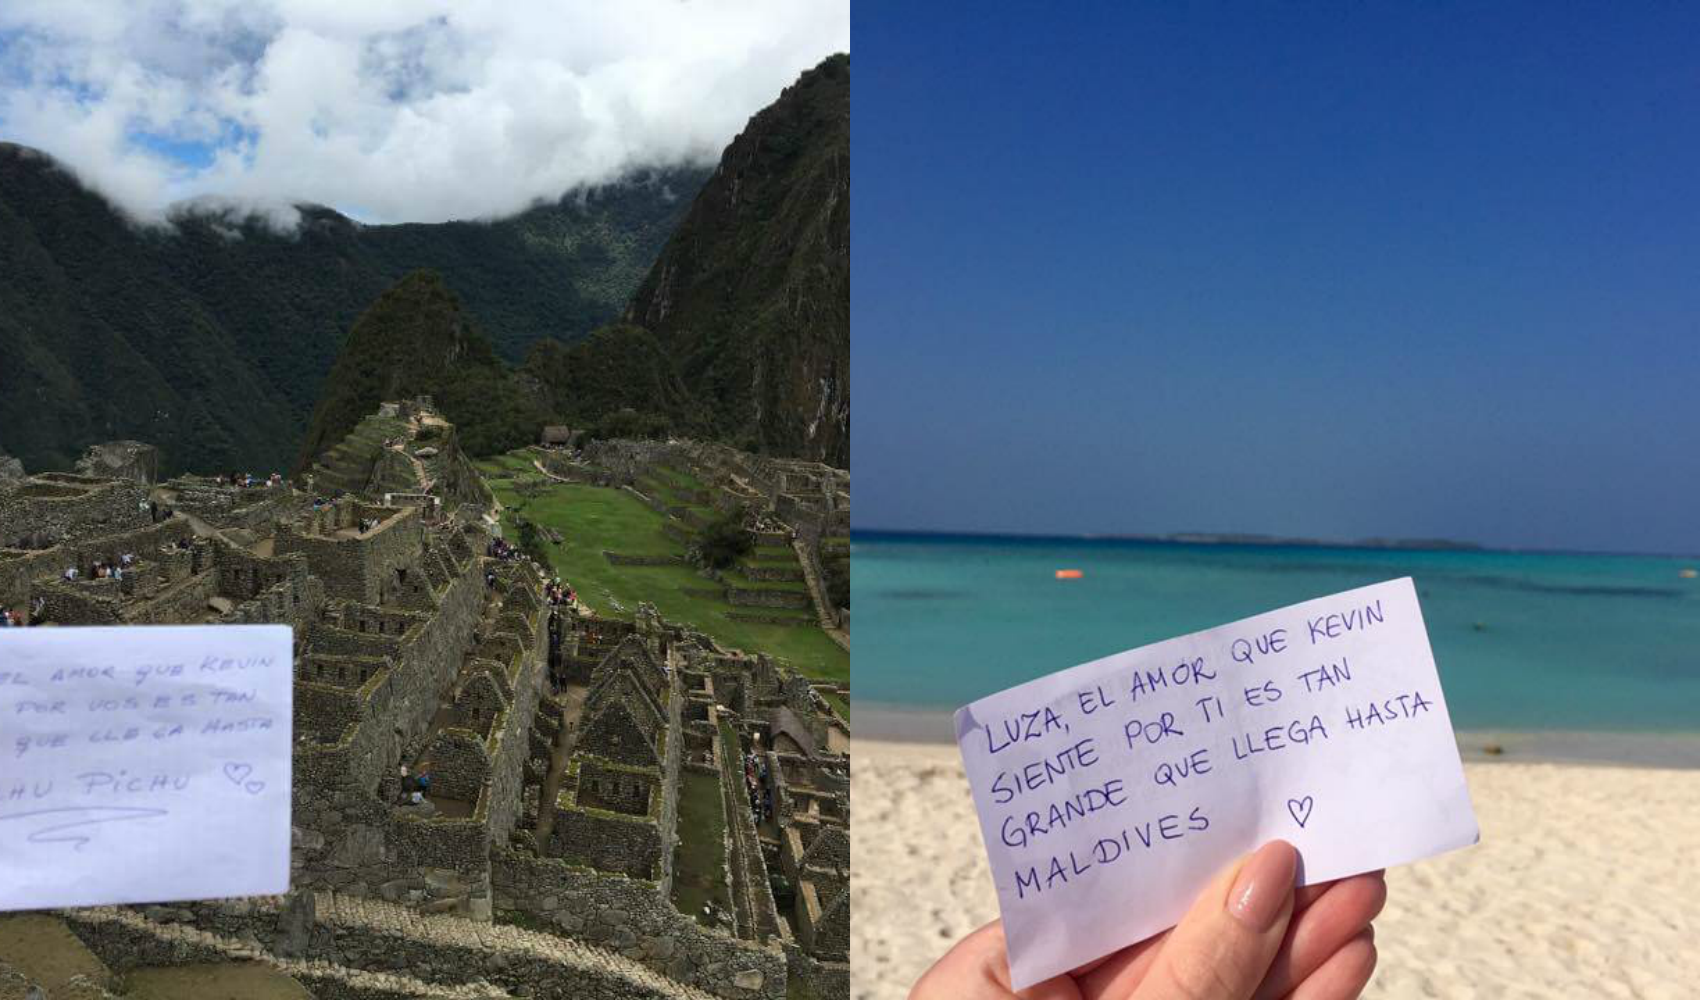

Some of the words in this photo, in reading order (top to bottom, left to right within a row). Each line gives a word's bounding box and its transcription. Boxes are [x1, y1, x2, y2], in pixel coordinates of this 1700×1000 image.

[50, 666, 115, 682] AMOR
[200, 655, 275, 673] KEVIN
[209, 689, 258, 704] TAN
[1078, 686, 1116, 716] EL
[1129, 657, 1218, 696] AMOR
[1230, 628, 1289, 664] QUE
[1306, 599, 1385, 646] KEVIN
[202, 718, 274, 734] HASTA
[990, 738, 1101, 805] SIENTE
[1124, 713, 1185, 751] POR
[1196, 695, 1225, 725] TI
[1244, 680, 1284, 709] ES
[1297, 657, 1354, 695] TAN
[1000, 780, 1129, 849] GRANDE
[1154, 749, 1214, 788] QUE
[1231, 715, 1330, 762] LLEGA
[1345, 689, 1435, 730] HASTA
[1013, 807, 1212, 901] MALDIVES
